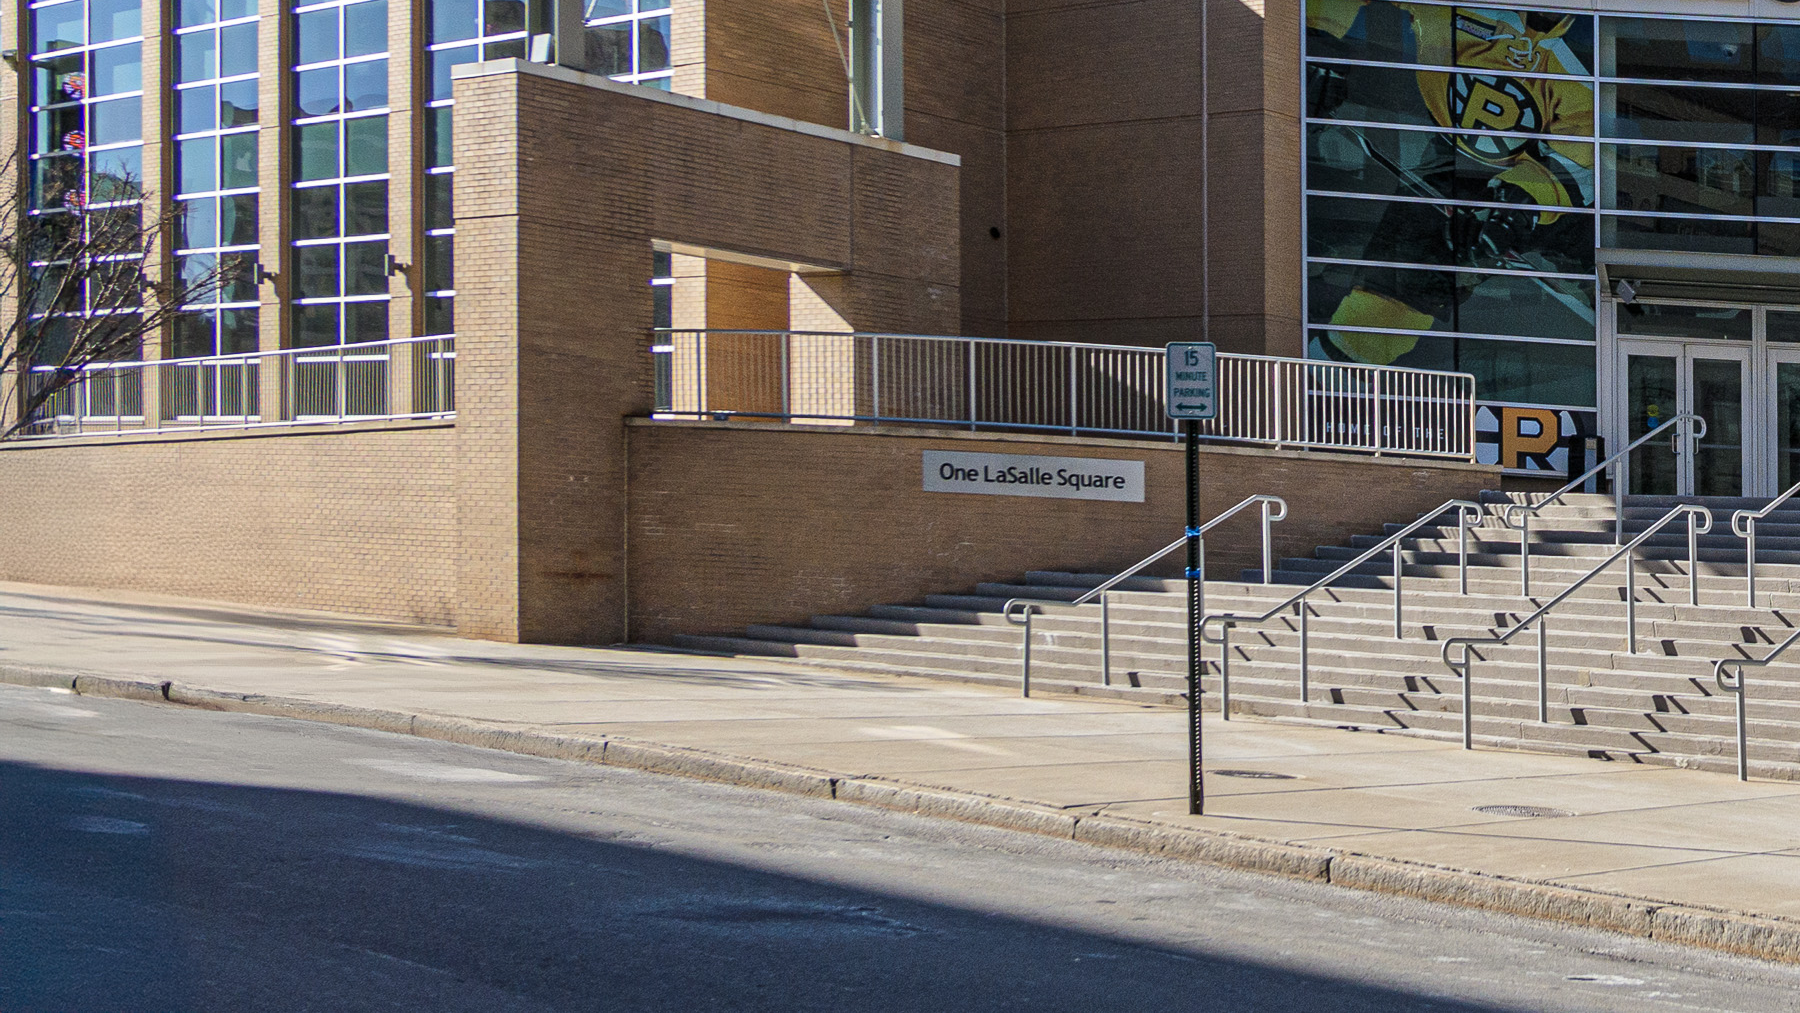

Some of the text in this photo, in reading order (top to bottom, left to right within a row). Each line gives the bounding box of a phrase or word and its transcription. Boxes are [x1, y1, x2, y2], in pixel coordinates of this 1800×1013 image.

[1184, 350, 1199, 367] 15
[1175, 371, 1208, 382] MINUTE
[1173, 387, 1211, 398] PARKING
[1326, 422, 1444, 440] HOME OF THE
[1502, 407, 1557, 468] P
[940, 463, 1126, 491] One LaSalle Square
